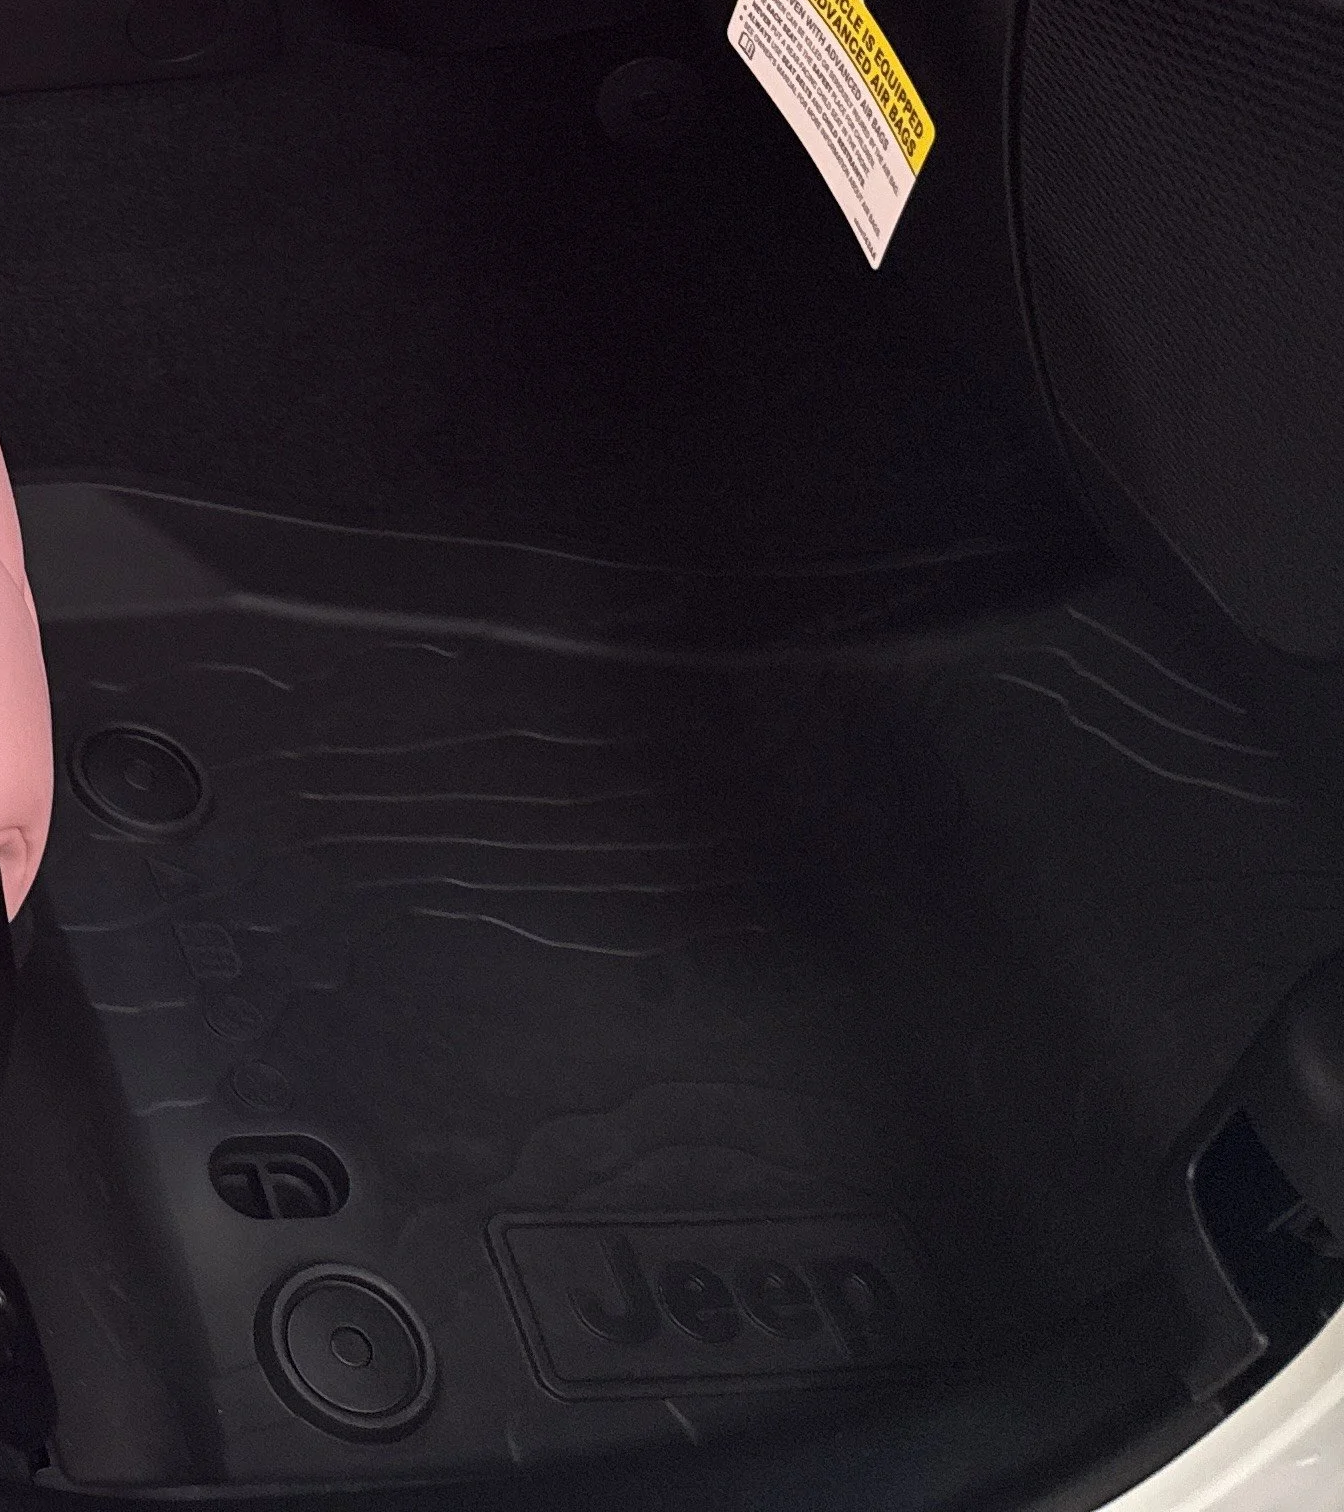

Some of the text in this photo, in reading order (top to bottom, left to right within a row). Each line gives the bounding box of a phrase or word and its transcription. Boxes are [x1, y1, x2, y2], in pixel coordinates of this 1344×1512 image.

[805, 14, 827, 47] WITH
[824, 43, 862, 101] ADVANCED
[859, 98, 873, 122] AIR
[870, 116, 890, 152] BAGS
[861, 27, 876, 53] IS
[873, 47, 924, 139] EQUIPPED
[869, 73, 890, 109] AIR
[888, 102, 917, 157] BAGS
[567, 1232, 896, 1360] Jeep
